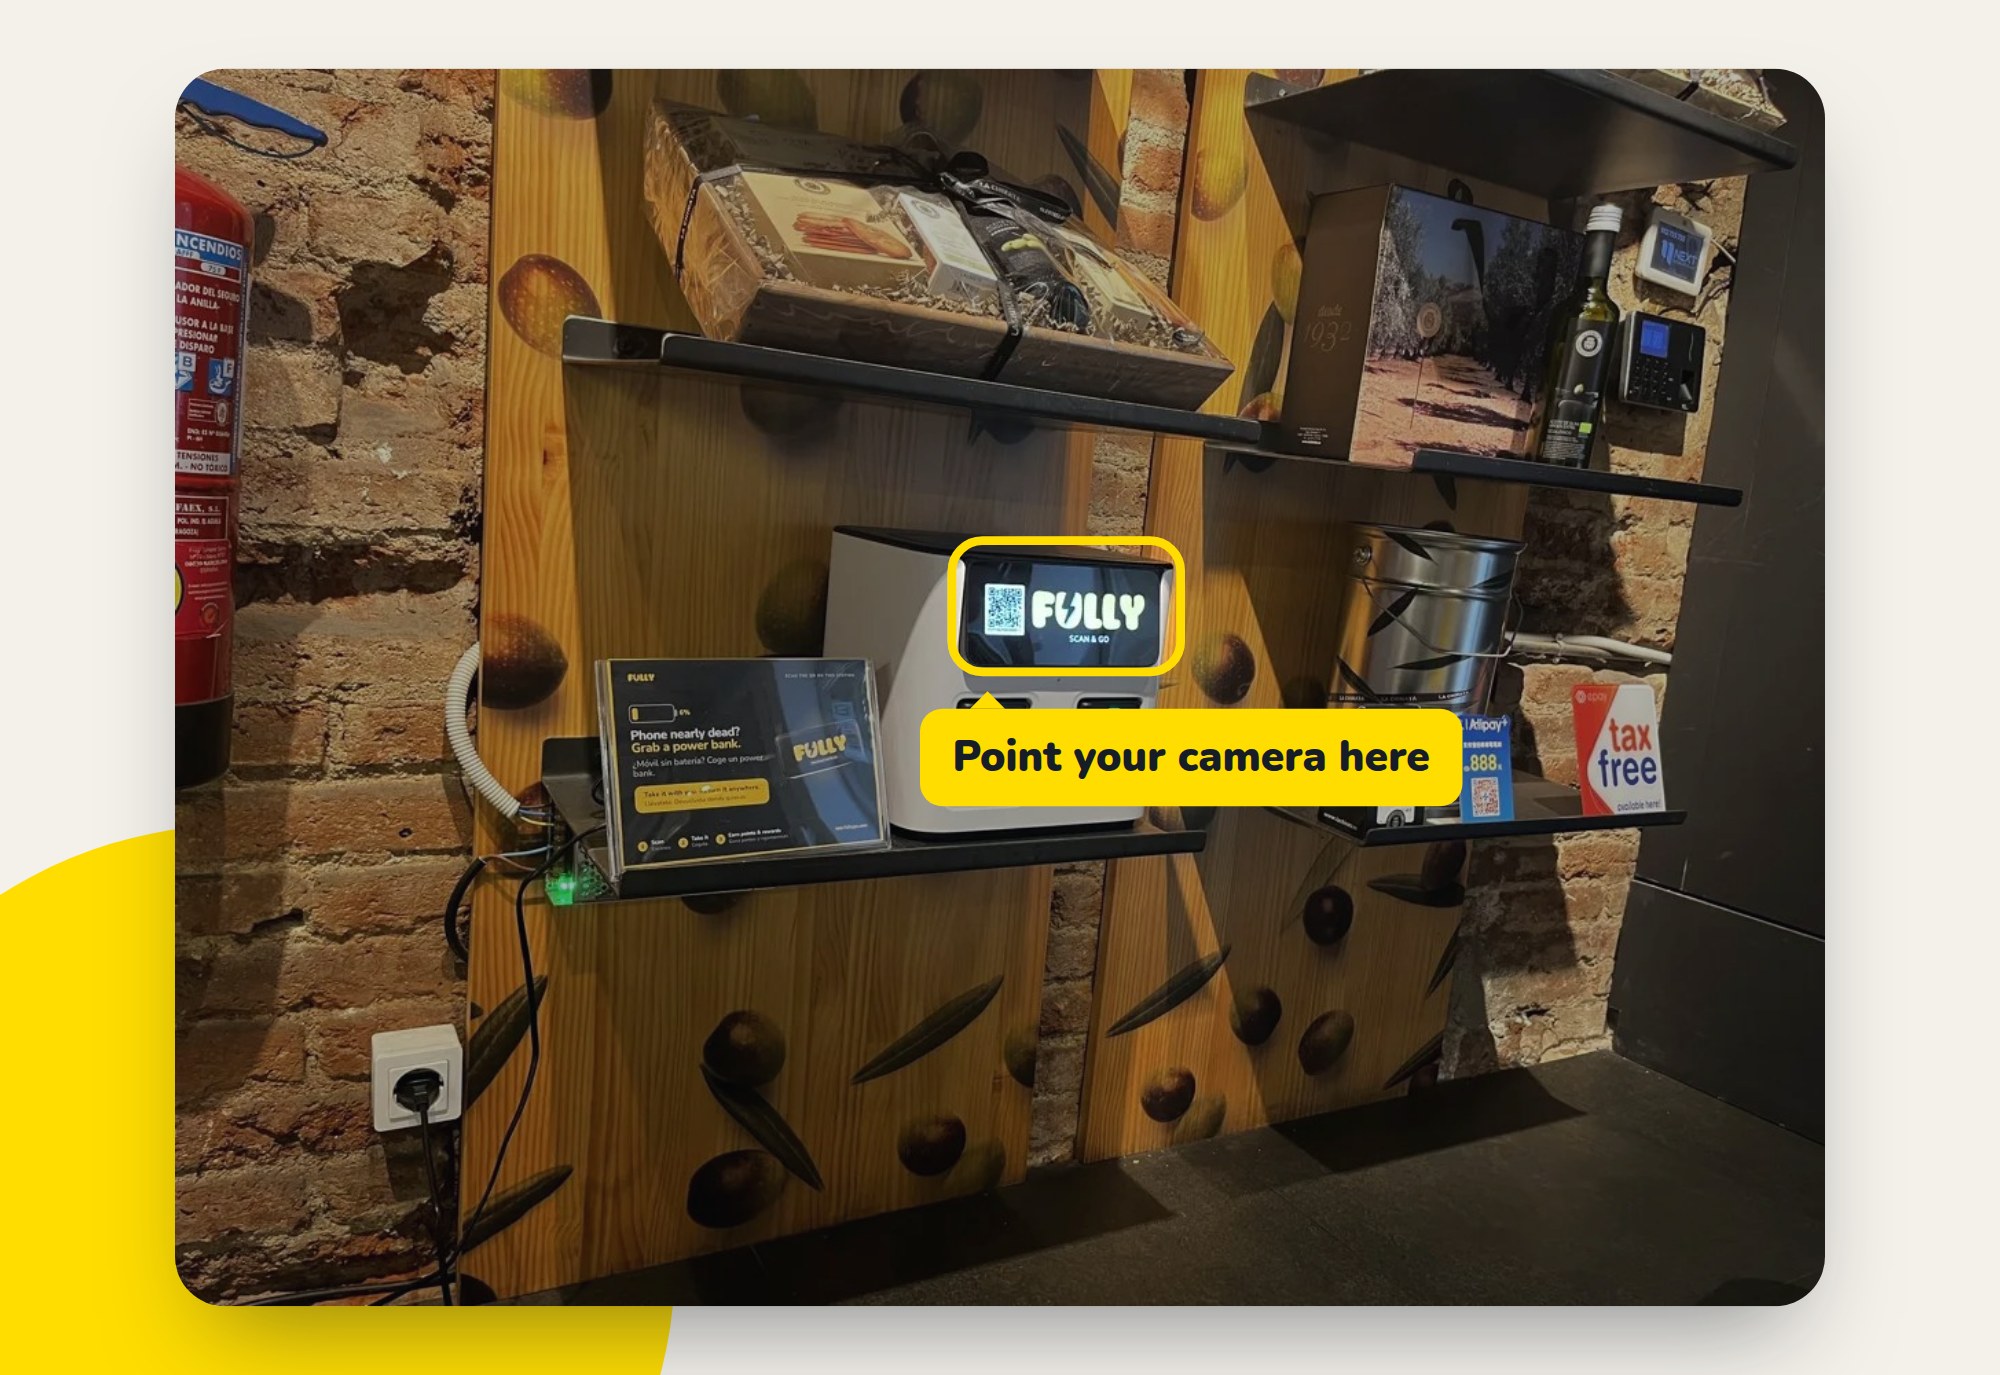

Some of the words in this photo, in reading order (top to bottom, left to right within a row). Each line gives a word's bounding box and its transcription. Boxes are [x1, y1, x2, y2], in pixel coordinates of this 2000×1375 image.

[177, 294, 188, 304] LA
[201, 319, 208, 329] A
[180, 341, 215, 354] DISPARO
[183, 356, 192, 367] B
[191, 462, 203, 471] NO
[1031, 590, 1146, 631] FULLY
[1069, 634, 1090, 643] SCAN
[1091, 635, 1097, 643] &
[1098, 635, 1110, 643] GO
[627, 673, 655, 682] FULLY
[630, 730, 668, 741] Phone
[670, 728, 705, 740] nearly
[708, 726, 740, 738] dead?
[1609, 718, 1652, 752] tax
[631, 742, 660, 753] Grab
[663, 744, 670, 752] a
[673, 742, 708, 753] power
[711, 739, 741, 750] bank.
[793, 734, 847, 762] FULLY
[661, 759, 672, 767] sin
[707, 756, 726, 765] Coge
[1470, 754, 1497, 771] 888
[633, 769, 655, 778] bank.
[1598, 749, 1657, 787] free
